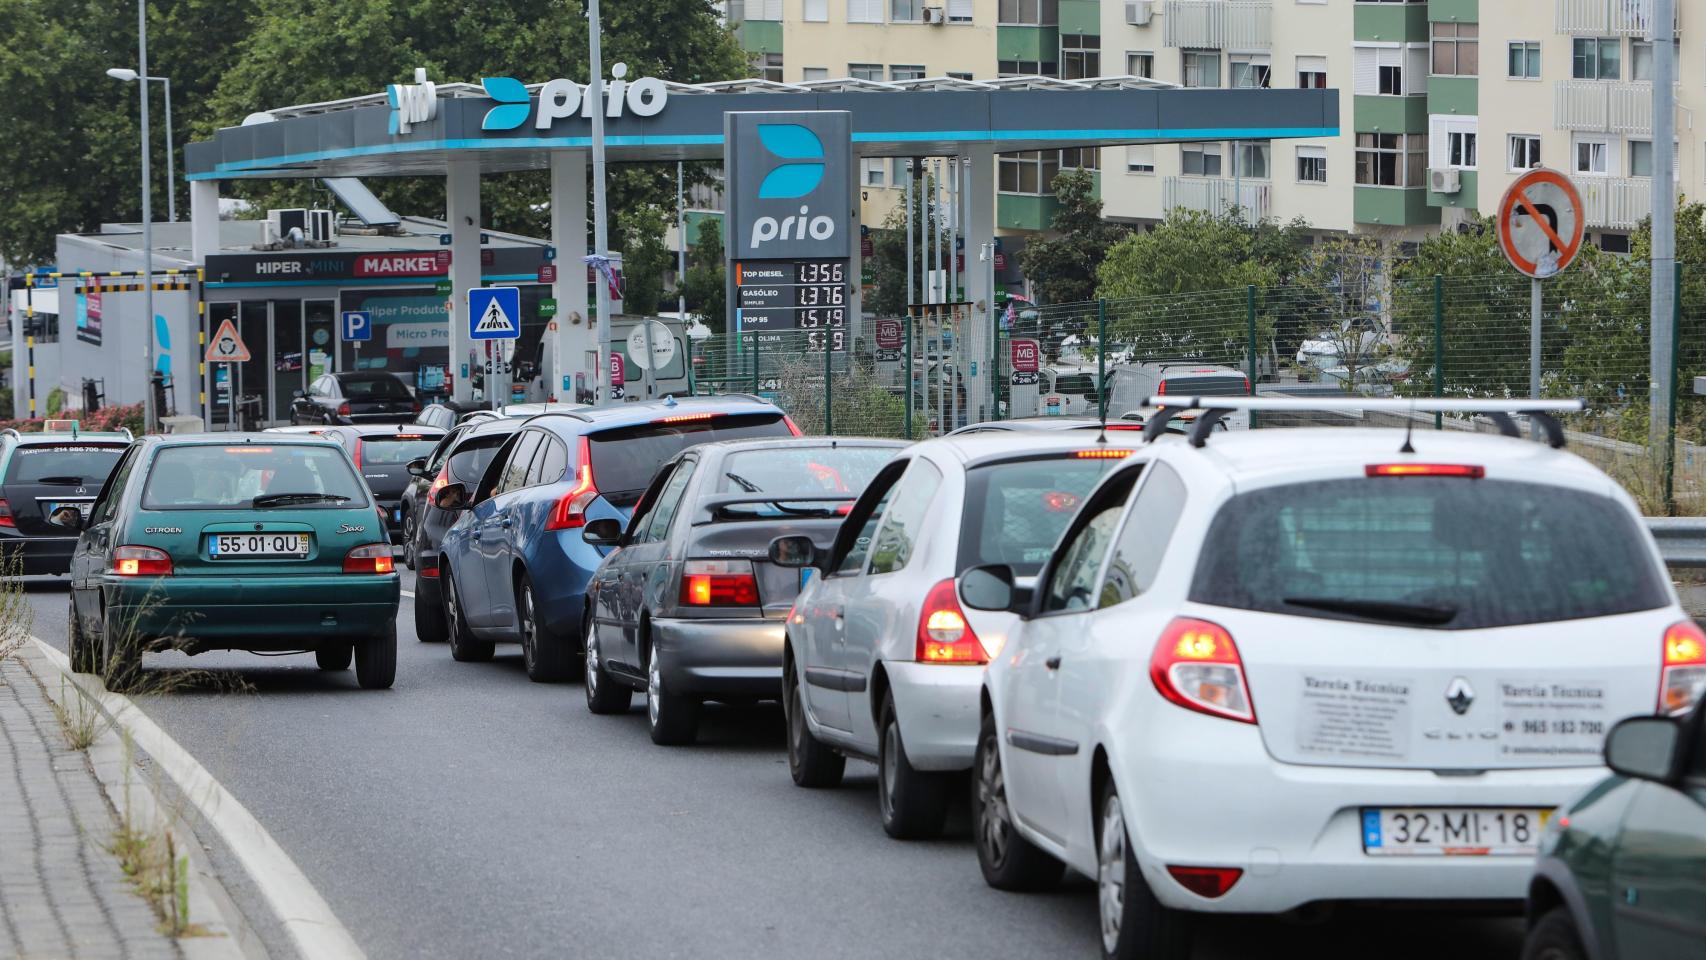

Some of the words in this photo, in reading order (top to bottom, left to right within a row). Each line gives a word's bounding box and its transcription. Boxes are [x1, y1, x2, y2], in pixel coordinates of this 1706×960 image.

[535, 62, 668, 129] prio
[750, 205, 835, 249] prio
[256, 262, 301, 273] HIPER
[310, 260, 344, 272] MINI
[364, 257, 438, 272] MARKET
[743, 289, 778, 297] GASÓLEO
[366, 305, 397, 317] Hiper
[401, 305, 448, 315] Produto
[348, 314, 365, 338] P
[396, 329, 427, 339] Micro
[881, 327, 897, 337] MB
[1016, 348, 1034, 359] MB
[336, 523, 366, 534] Saxo
